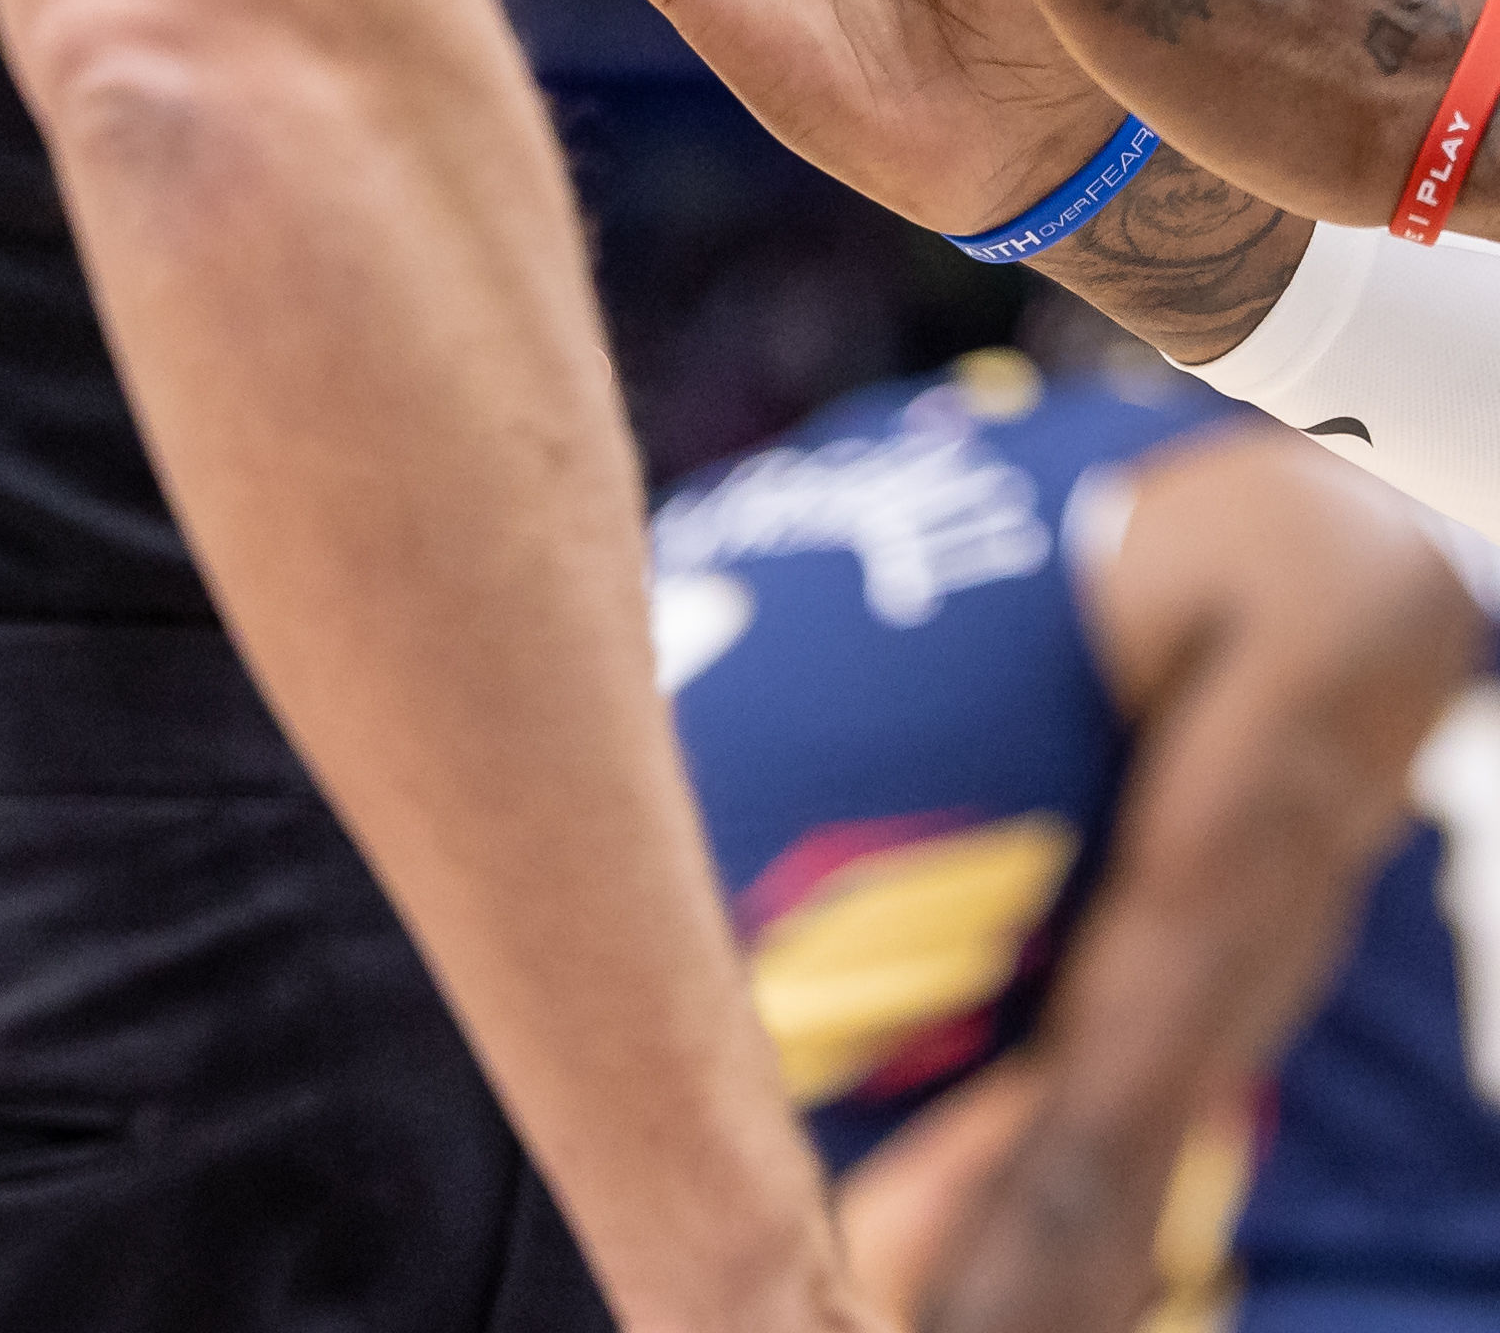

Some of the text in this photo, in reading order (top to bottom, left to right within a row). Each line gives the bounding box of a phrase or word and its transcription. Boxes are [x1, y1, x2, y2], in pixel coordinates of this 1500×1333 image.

[963, 127, 1155, 260] AITH OVER FEAR
[1416, 111, 1471, 207] PLAY
